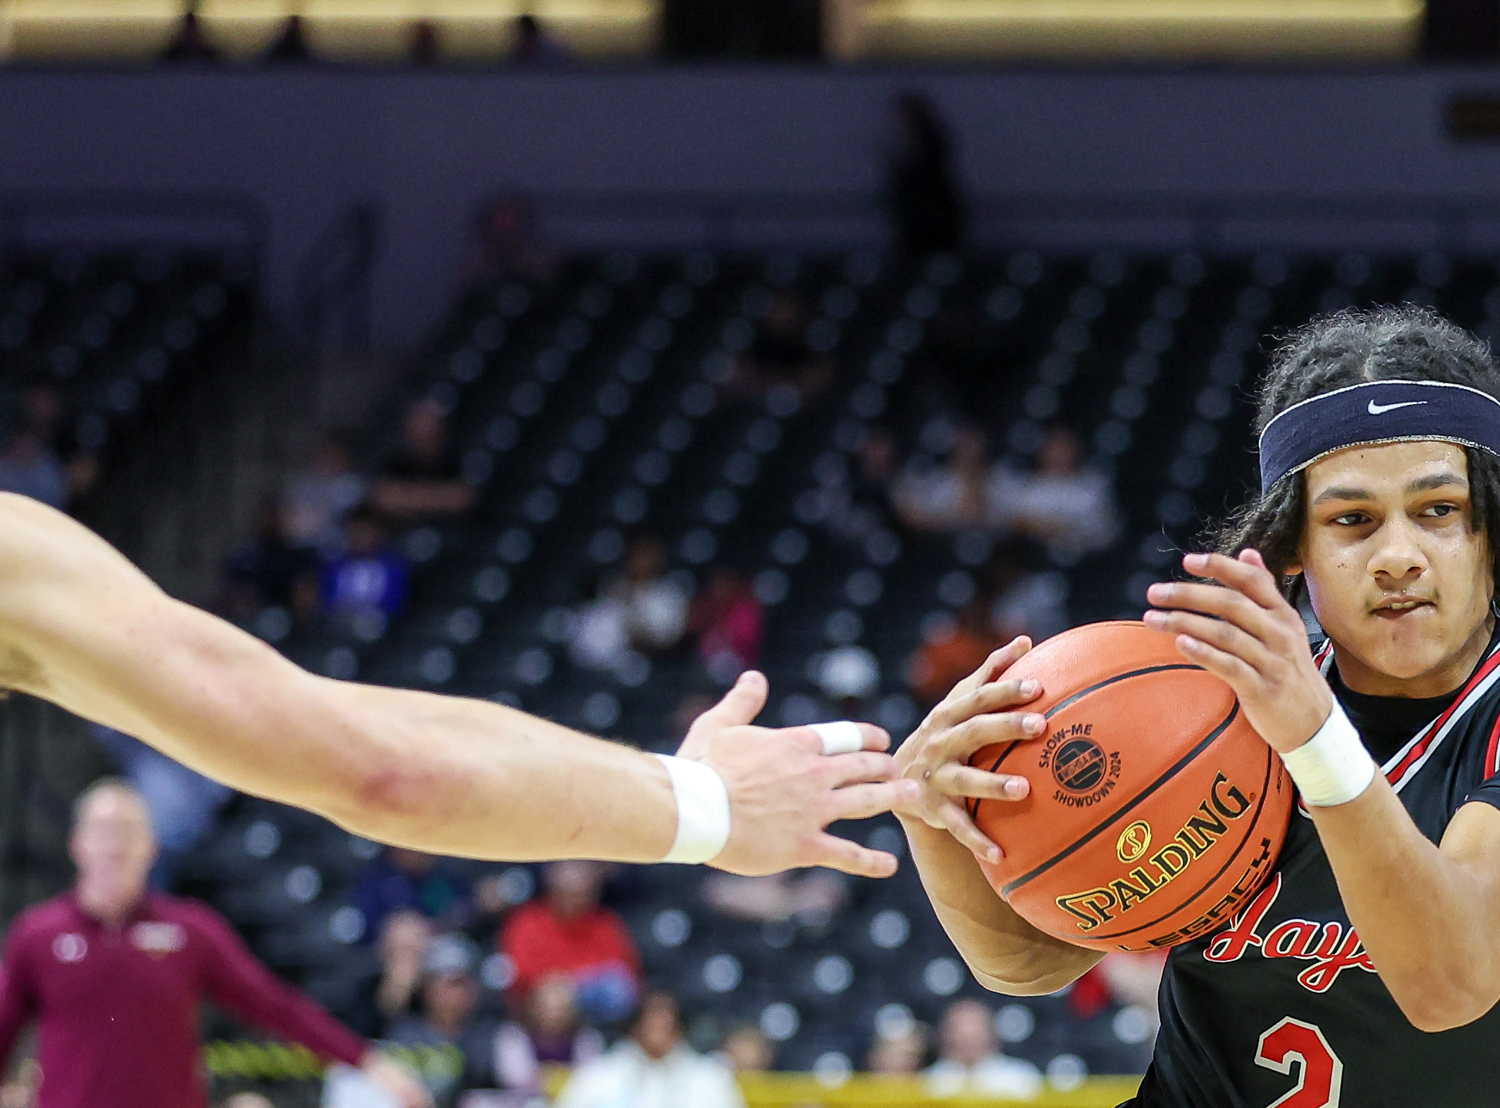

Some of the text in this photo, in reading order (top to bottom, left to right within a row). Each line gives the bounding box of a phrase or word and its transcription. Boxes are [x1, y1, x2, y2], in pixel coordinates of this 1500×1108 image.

[1038, 723, 1093, 769] SHOW-ME
[1053, 778, 1116, 808] SHOWDOWN
[1055, 770, 1252, 932] SPALDING
